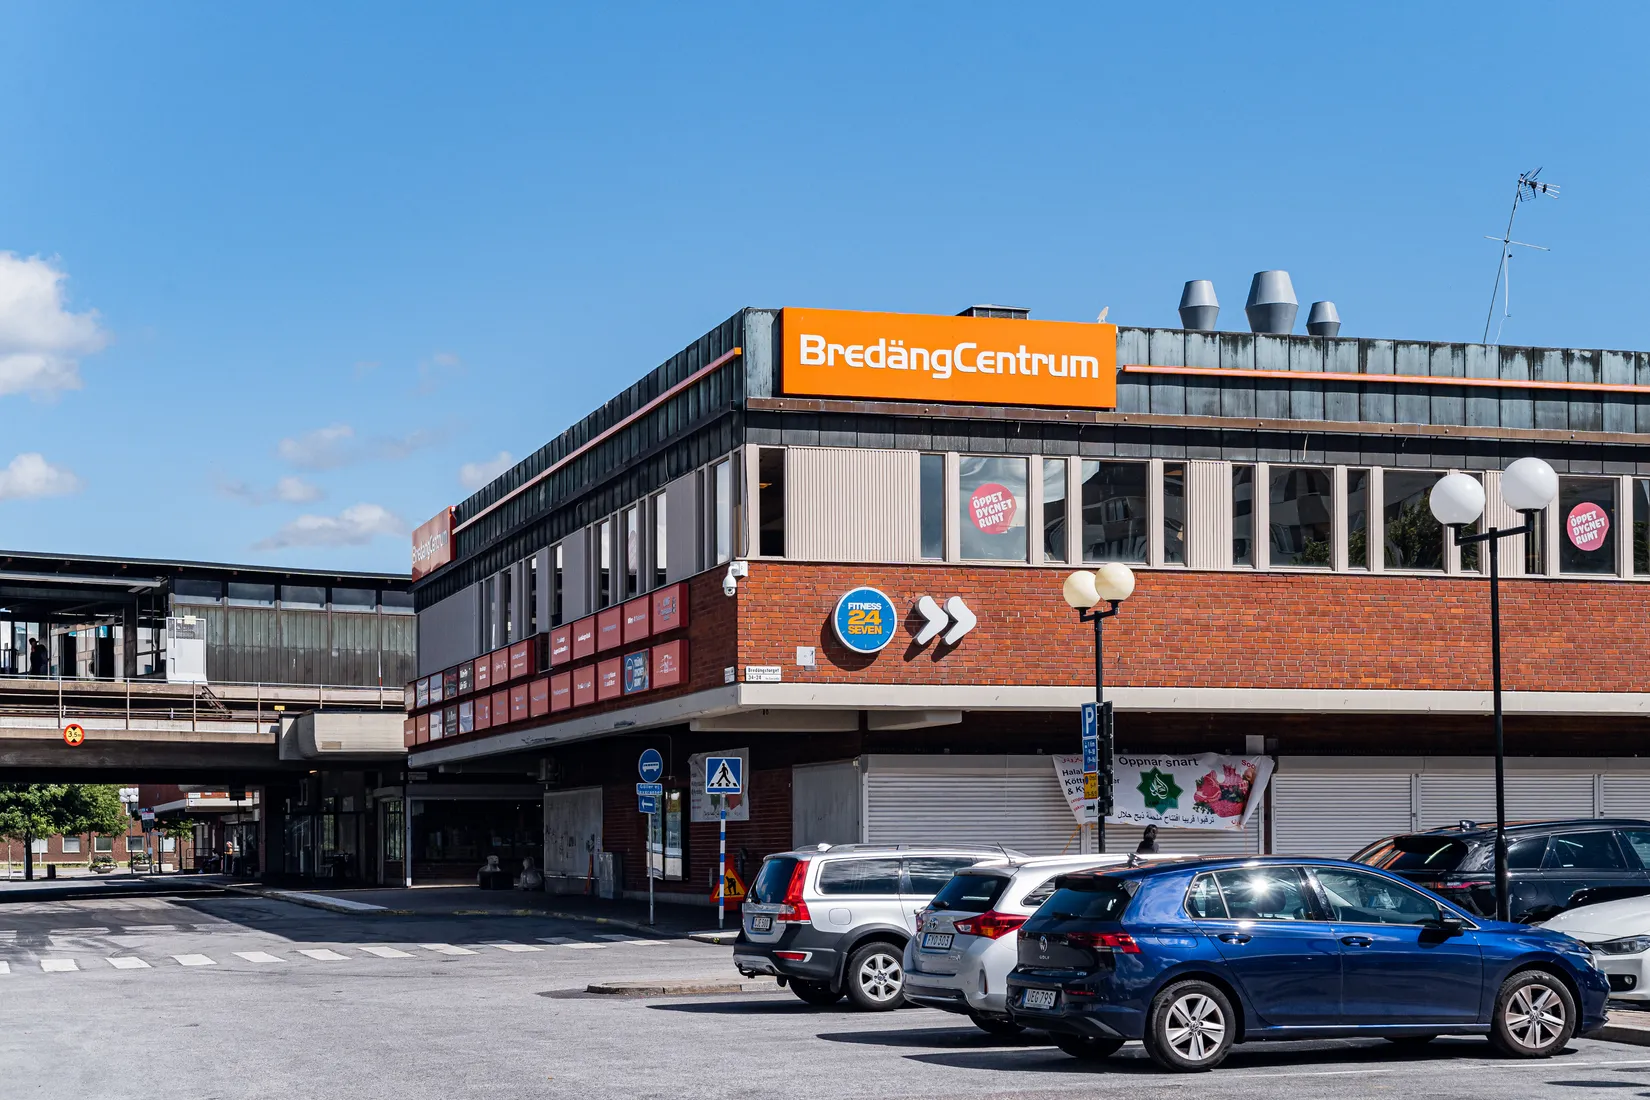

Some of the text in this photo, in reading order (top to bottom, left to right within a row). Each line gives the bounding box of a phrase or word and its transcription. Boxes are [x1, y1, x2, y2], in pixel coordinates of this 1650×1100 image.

[799, 333, 1100, 380] BredängCentrum
[972, 491, 1003, 509] ÖPPET
[975, 498, 1013, 519] DYGNET
[978, 512, 1004, 529] RUNT
[1570, 510, 1597, 527] ÖPPET
[1572, 517, 1606, 536] DYGNET
[1575, 529, 1599, 545] RUNT
[847, 602, 882, 610] FITNESS
[847, 609, 882, 626] 24
[847, 625, 883, 635] SEVEN
[1085, 706, 1095, 734] P
[1165, 758, 1199, 768] snart
[1062, 768, 1083, 776] Halal
